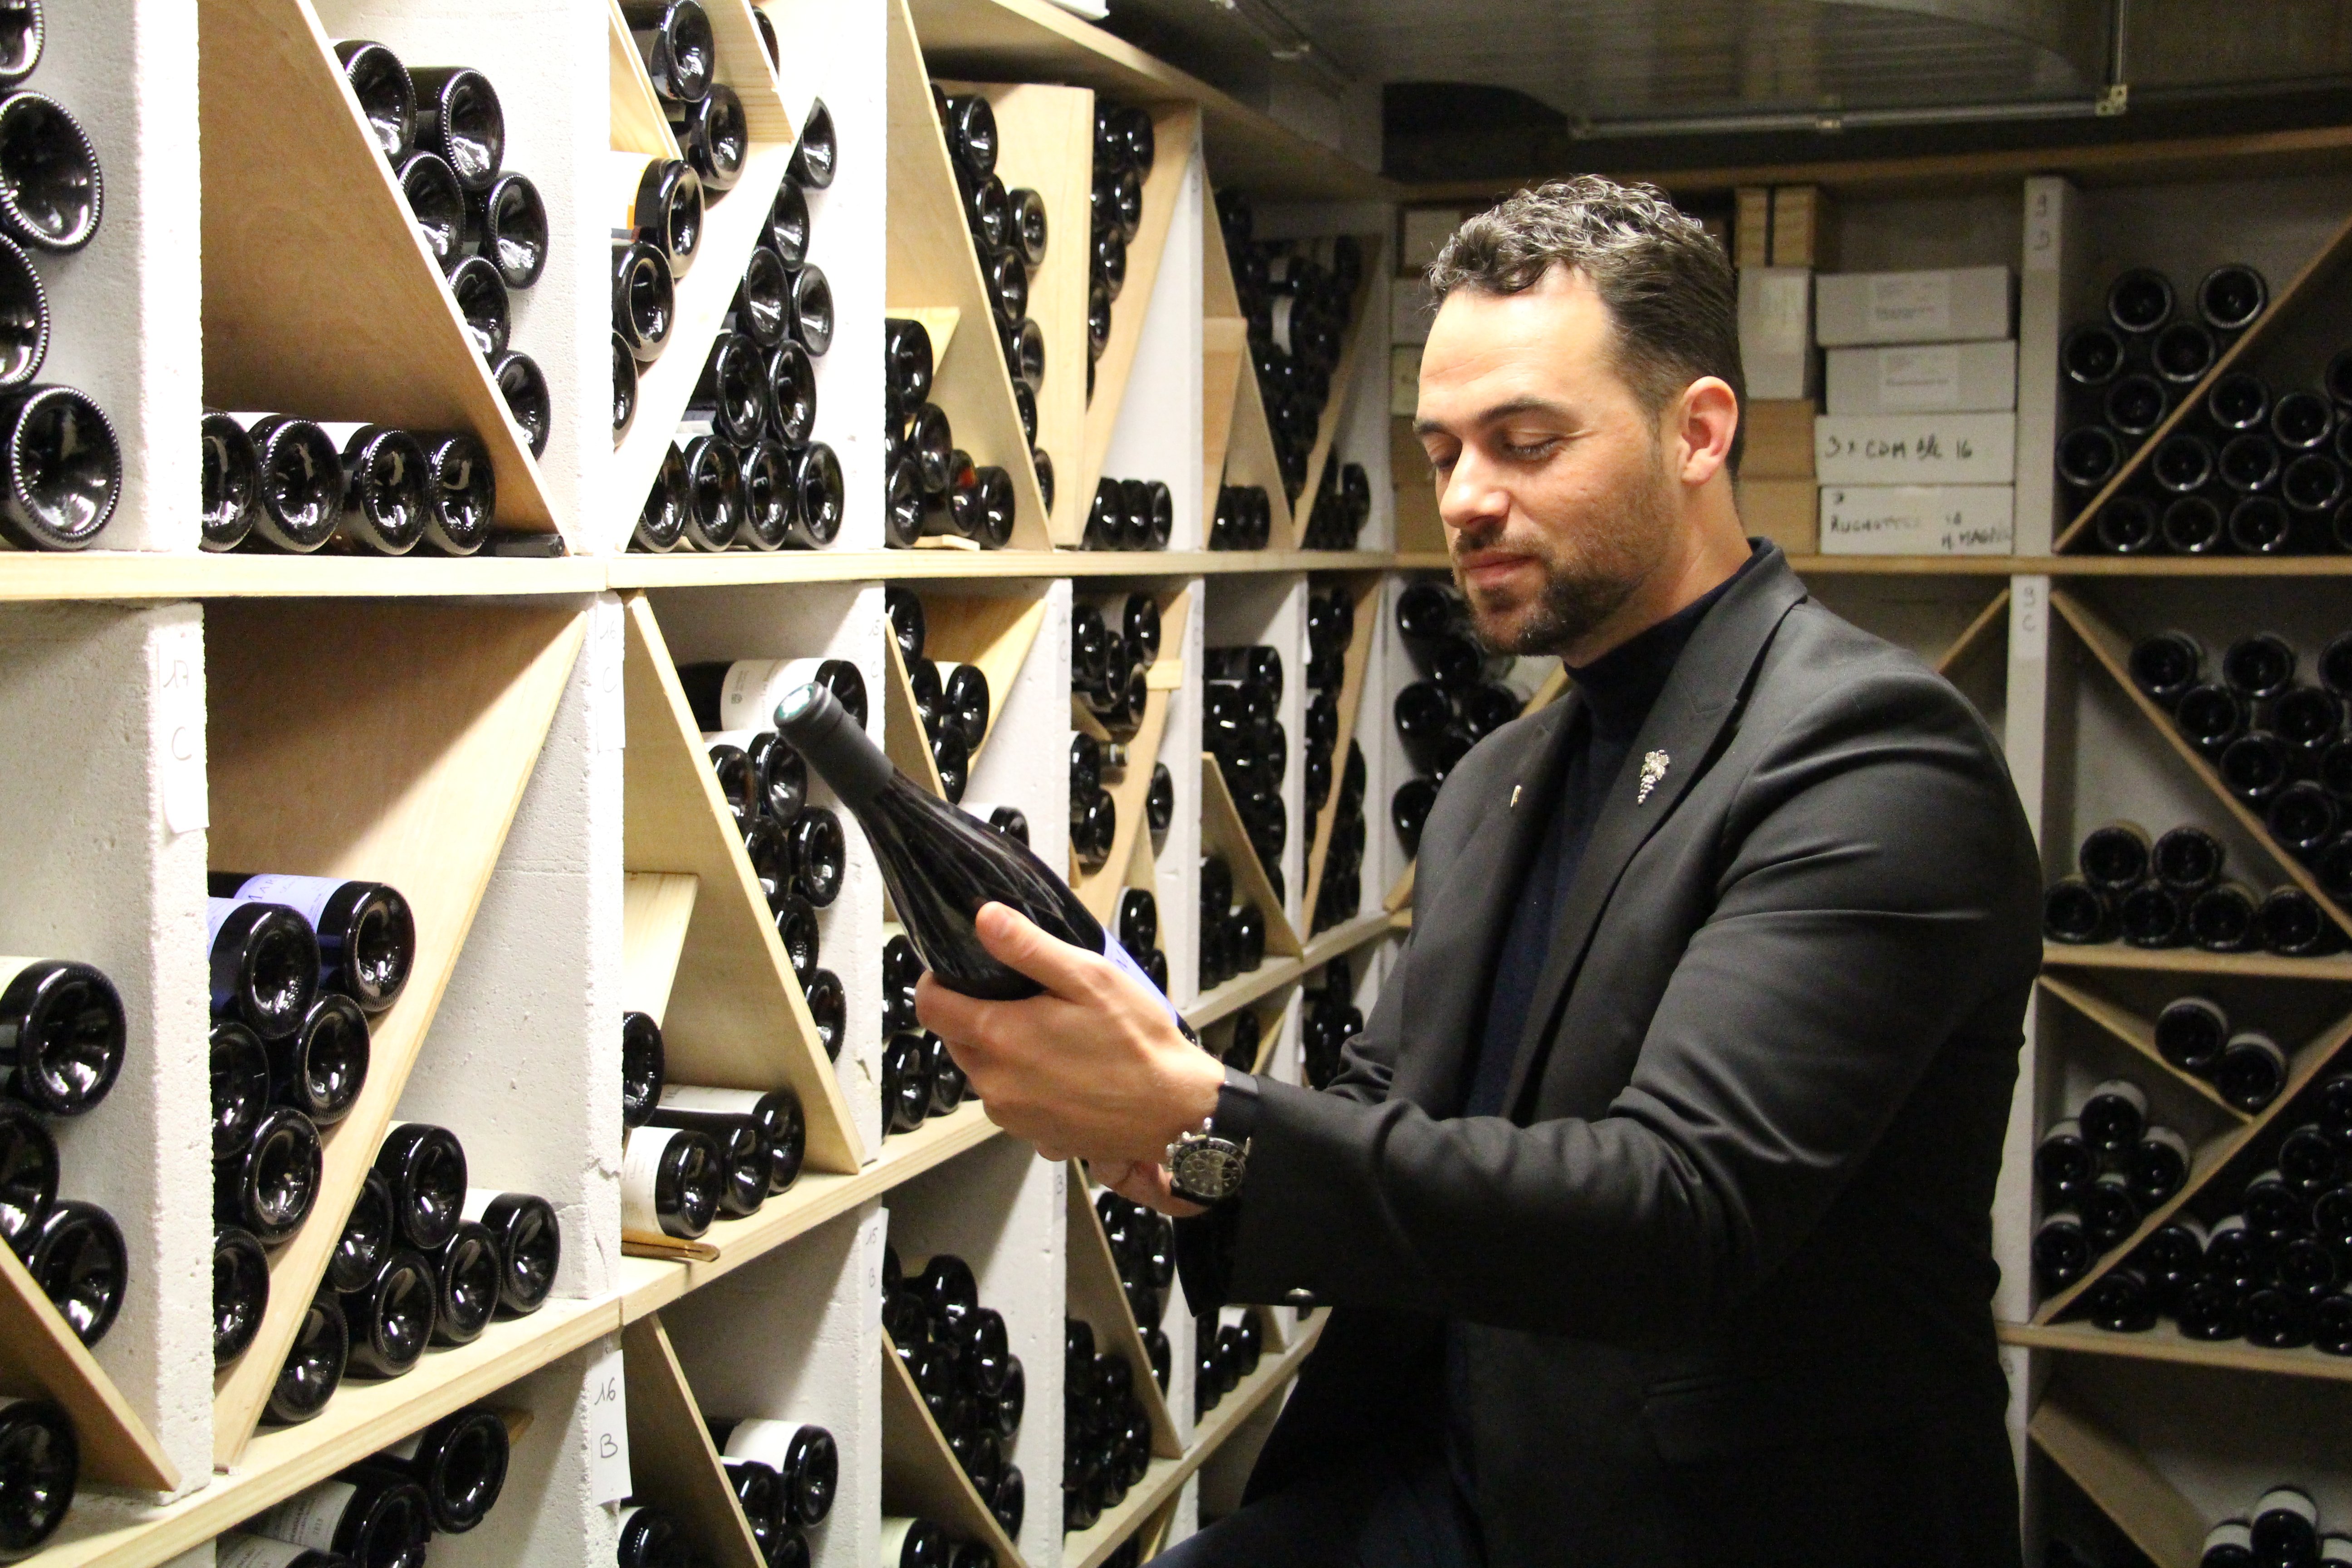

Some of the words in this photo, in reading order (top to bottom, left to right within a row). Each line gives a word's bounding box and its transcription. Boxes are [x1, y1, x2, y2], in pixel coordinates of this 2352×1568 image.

[599, 619, 616, 640] 16
[2022, 614, 2036, 632] C
[602, 666, 617, 694] C
[871, 660, 879, 679] C
[172, 726, 192, 761] C
[594, 1377, 616, 1406] 16
[600, 1433, 618, 1459] B
